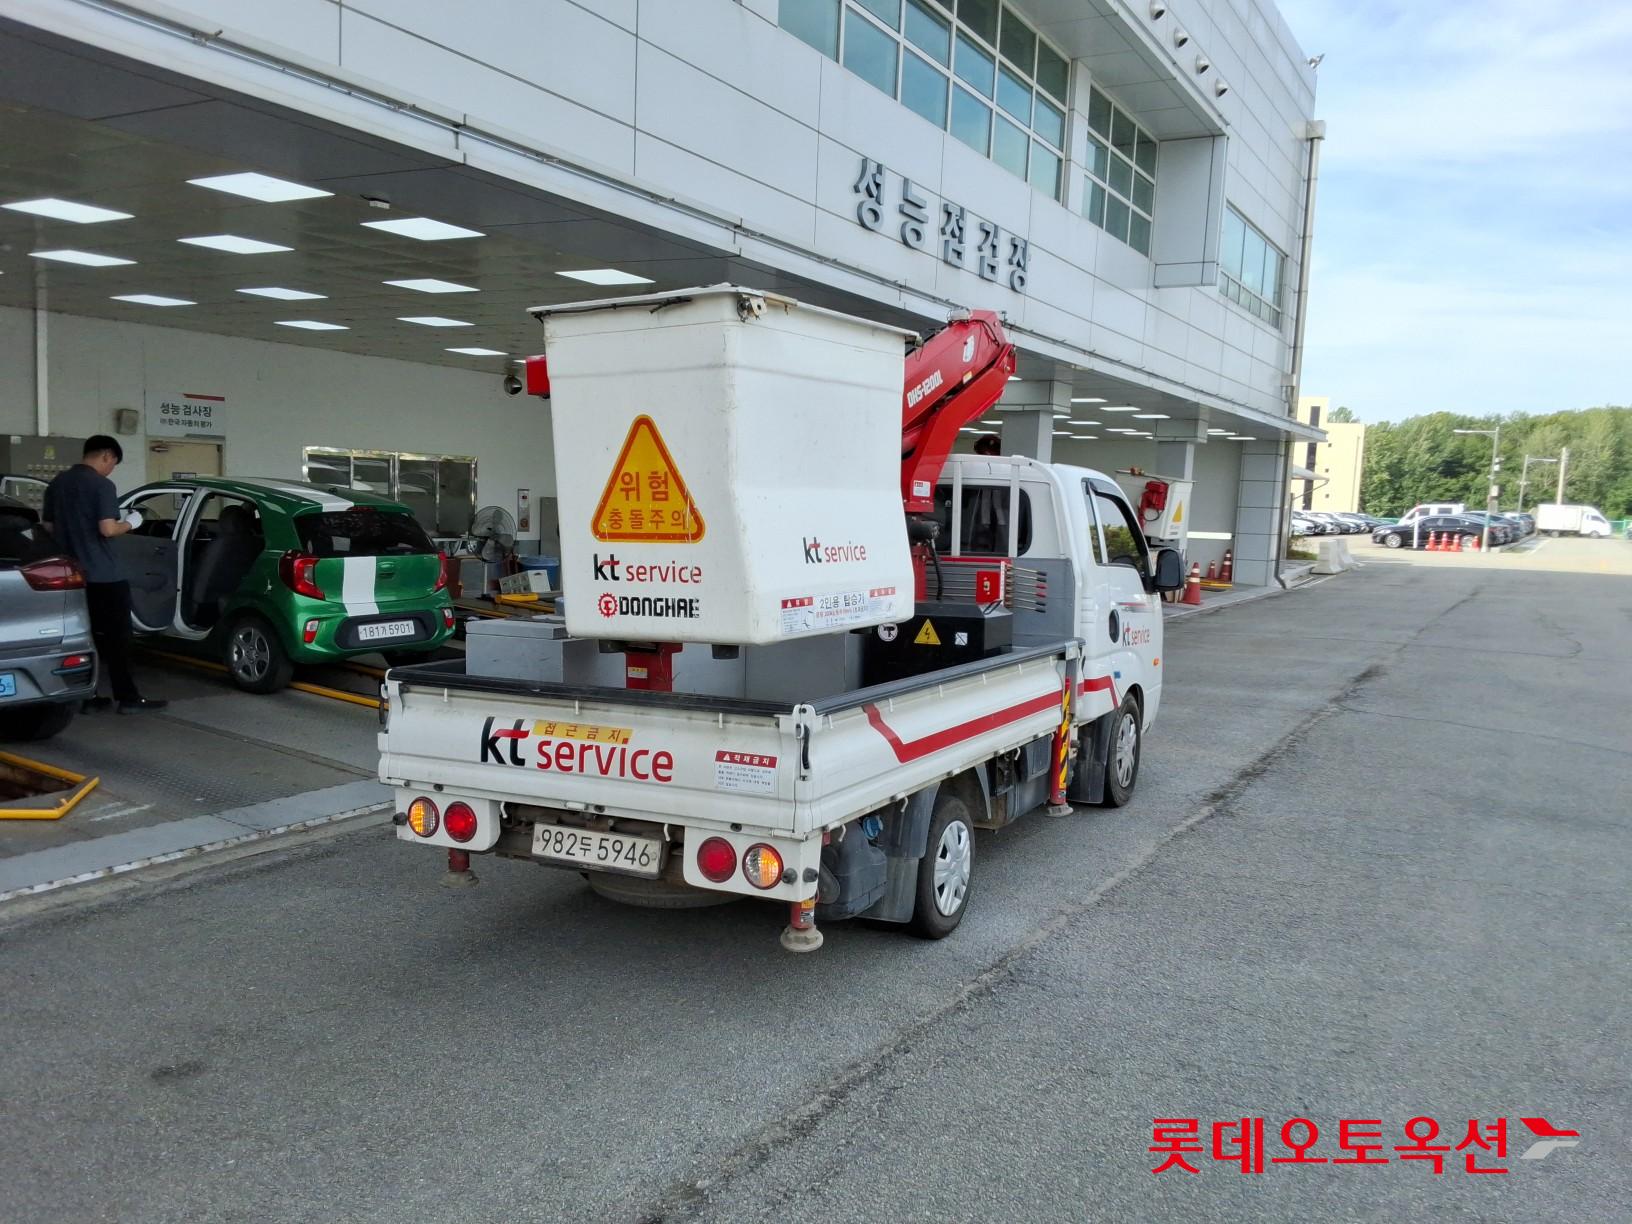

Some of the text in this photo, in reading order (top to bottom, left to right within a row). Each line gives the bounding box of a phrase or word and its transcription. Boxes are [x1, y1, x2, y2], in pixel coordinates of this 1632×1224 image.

[853, 158, 1029, 293] 성능점검장
[160, 402, 212, 417] 성능 검사장
[803, 536, 867, 564] kt service
[593, 553, 702, 583] kt service
[619, 596, 700, 618] DONGHAE
[1122, 621, 1131, 647] kt
[480, 716, 530, 766] kt
[536, 737, 674, 782] service
